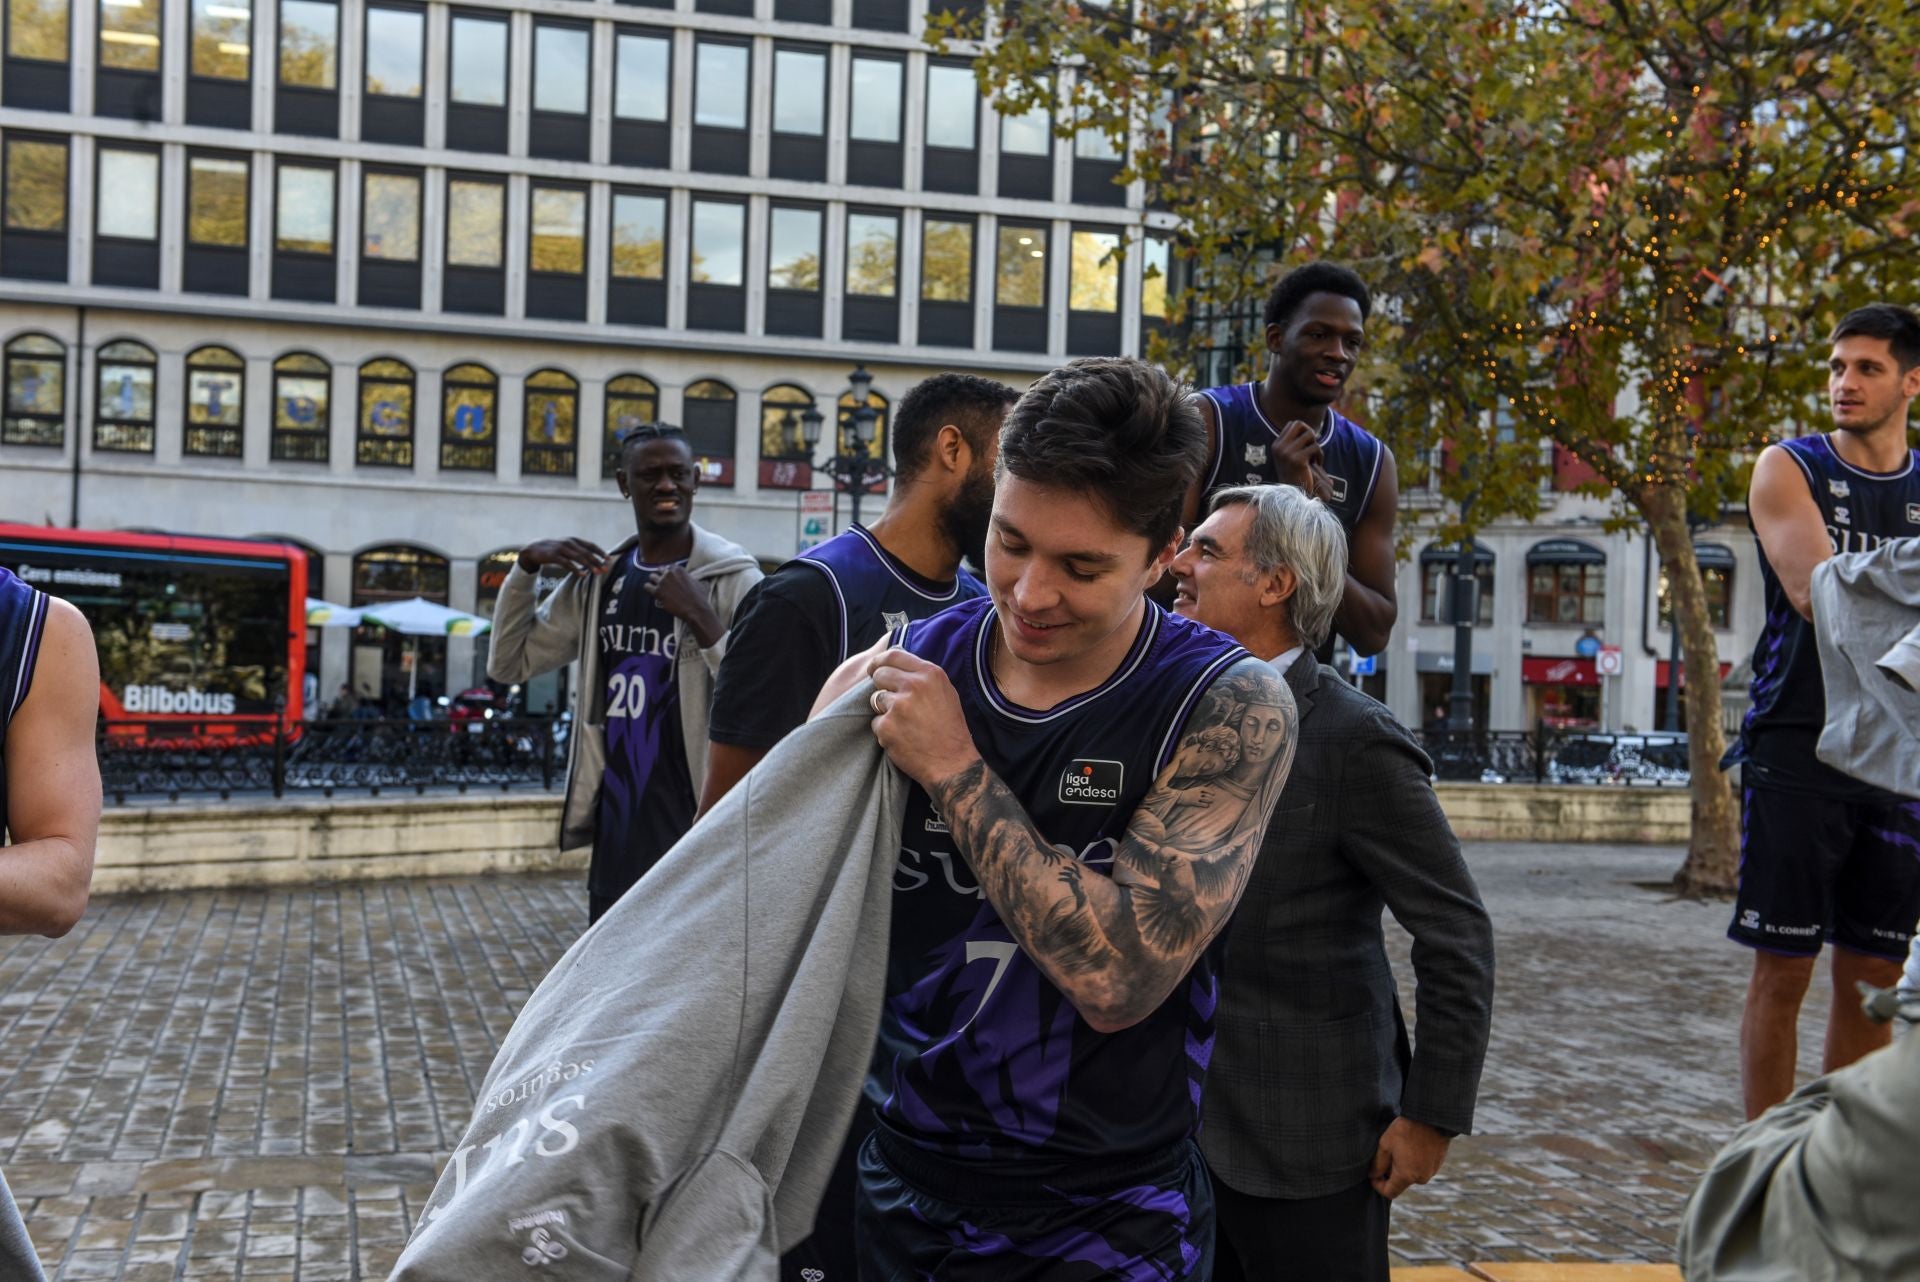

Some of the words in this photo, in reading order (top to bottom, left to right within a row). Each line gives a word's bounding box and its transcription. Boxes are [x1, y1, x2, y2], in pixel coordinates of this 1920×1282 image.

[18, 564, 50, 582] Cero
[53, 567, 122, 588] emisiones
[124, 684, 236, 715] Bilbobus
[606, 673, 646, 720] 20
[1066, 772, 1090, 787] liga
[1065, 785, 1117, 799] endesa
[1765, 923, 1778, 934] EL
[1872, 928, 1910, 942] NISS
[958, 940, 1020, 1034] 7
[485, 1058, 596, 1114] seguros
